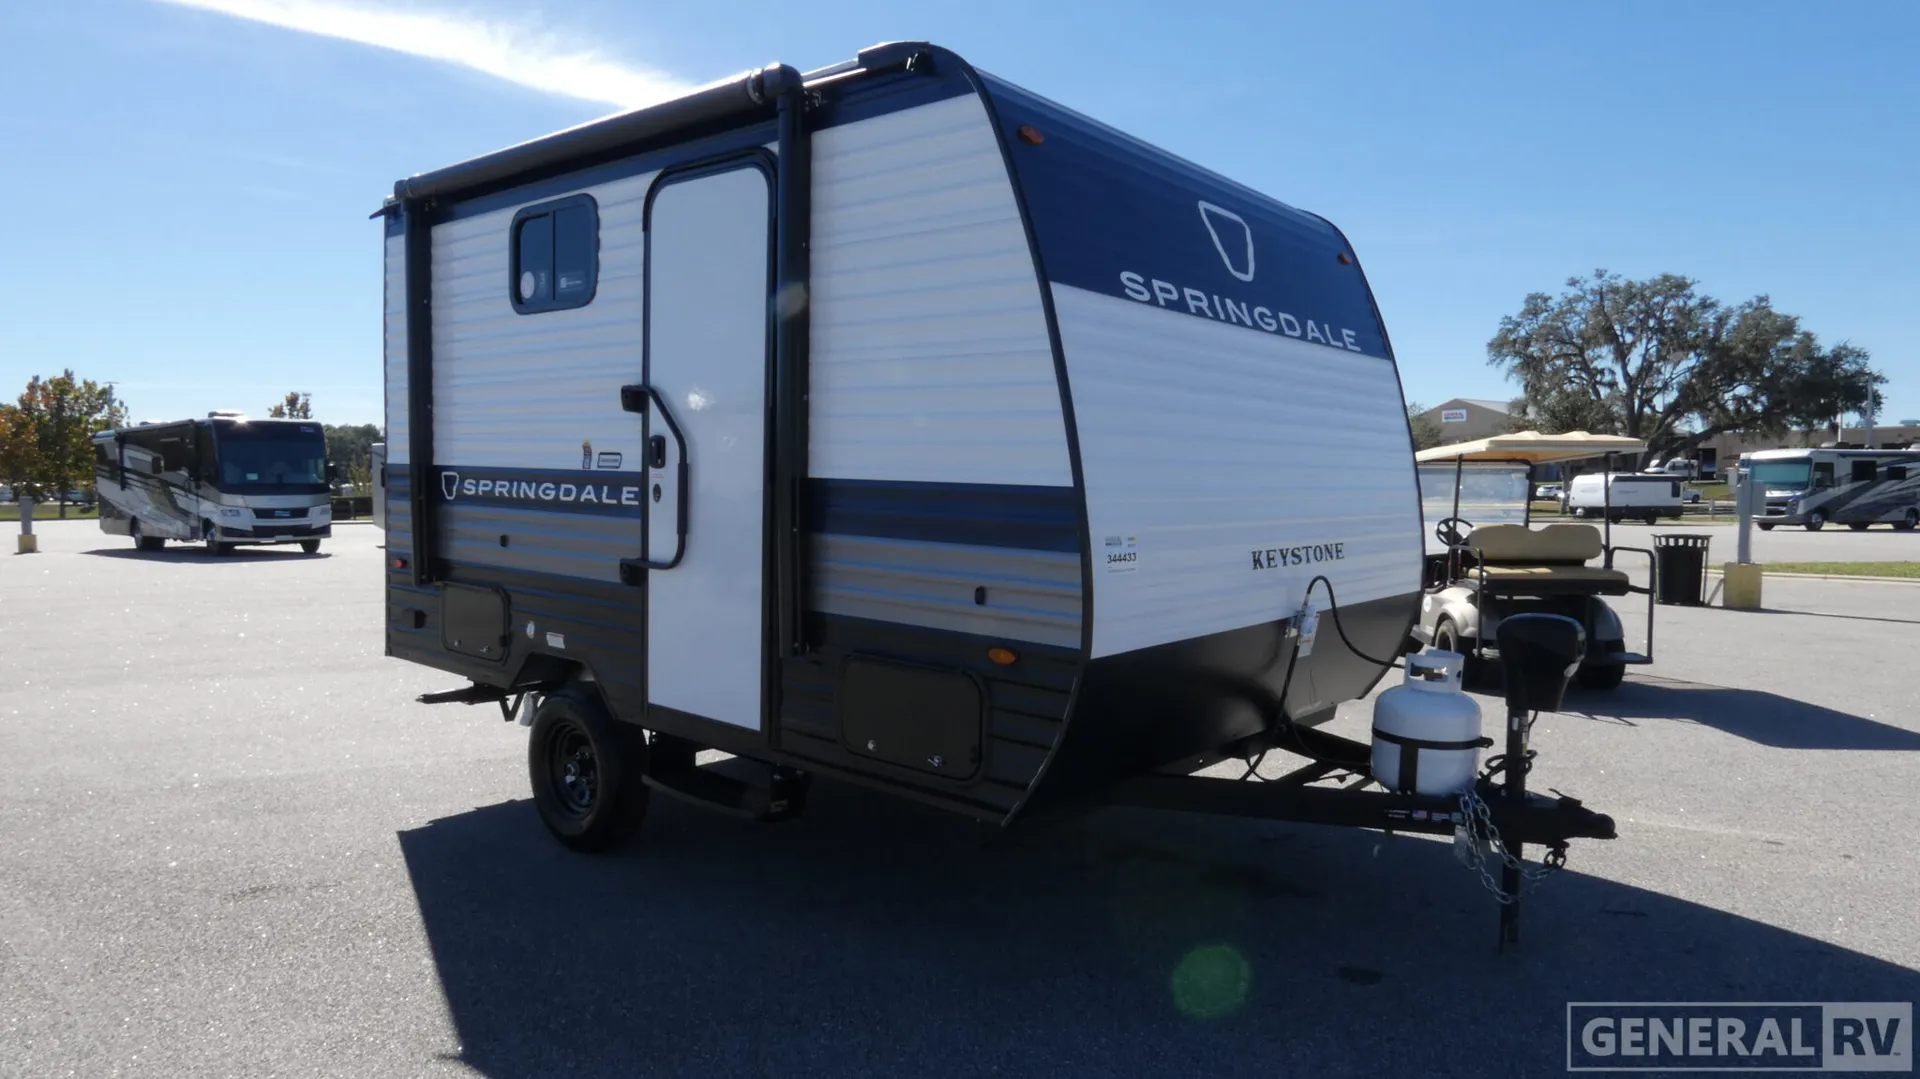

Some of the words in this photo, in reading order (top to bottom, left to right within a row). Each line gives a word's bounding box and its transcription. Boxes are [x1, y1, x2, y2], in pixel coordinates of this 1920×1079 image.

[1119, 271, 1361, 351] SPRINGDALE
[463, 479, 639, 505] SPRINGDALE
[1107, 552, 1137, 564] 344433
[1251, 542, 1345, 571] KEYSTONE
